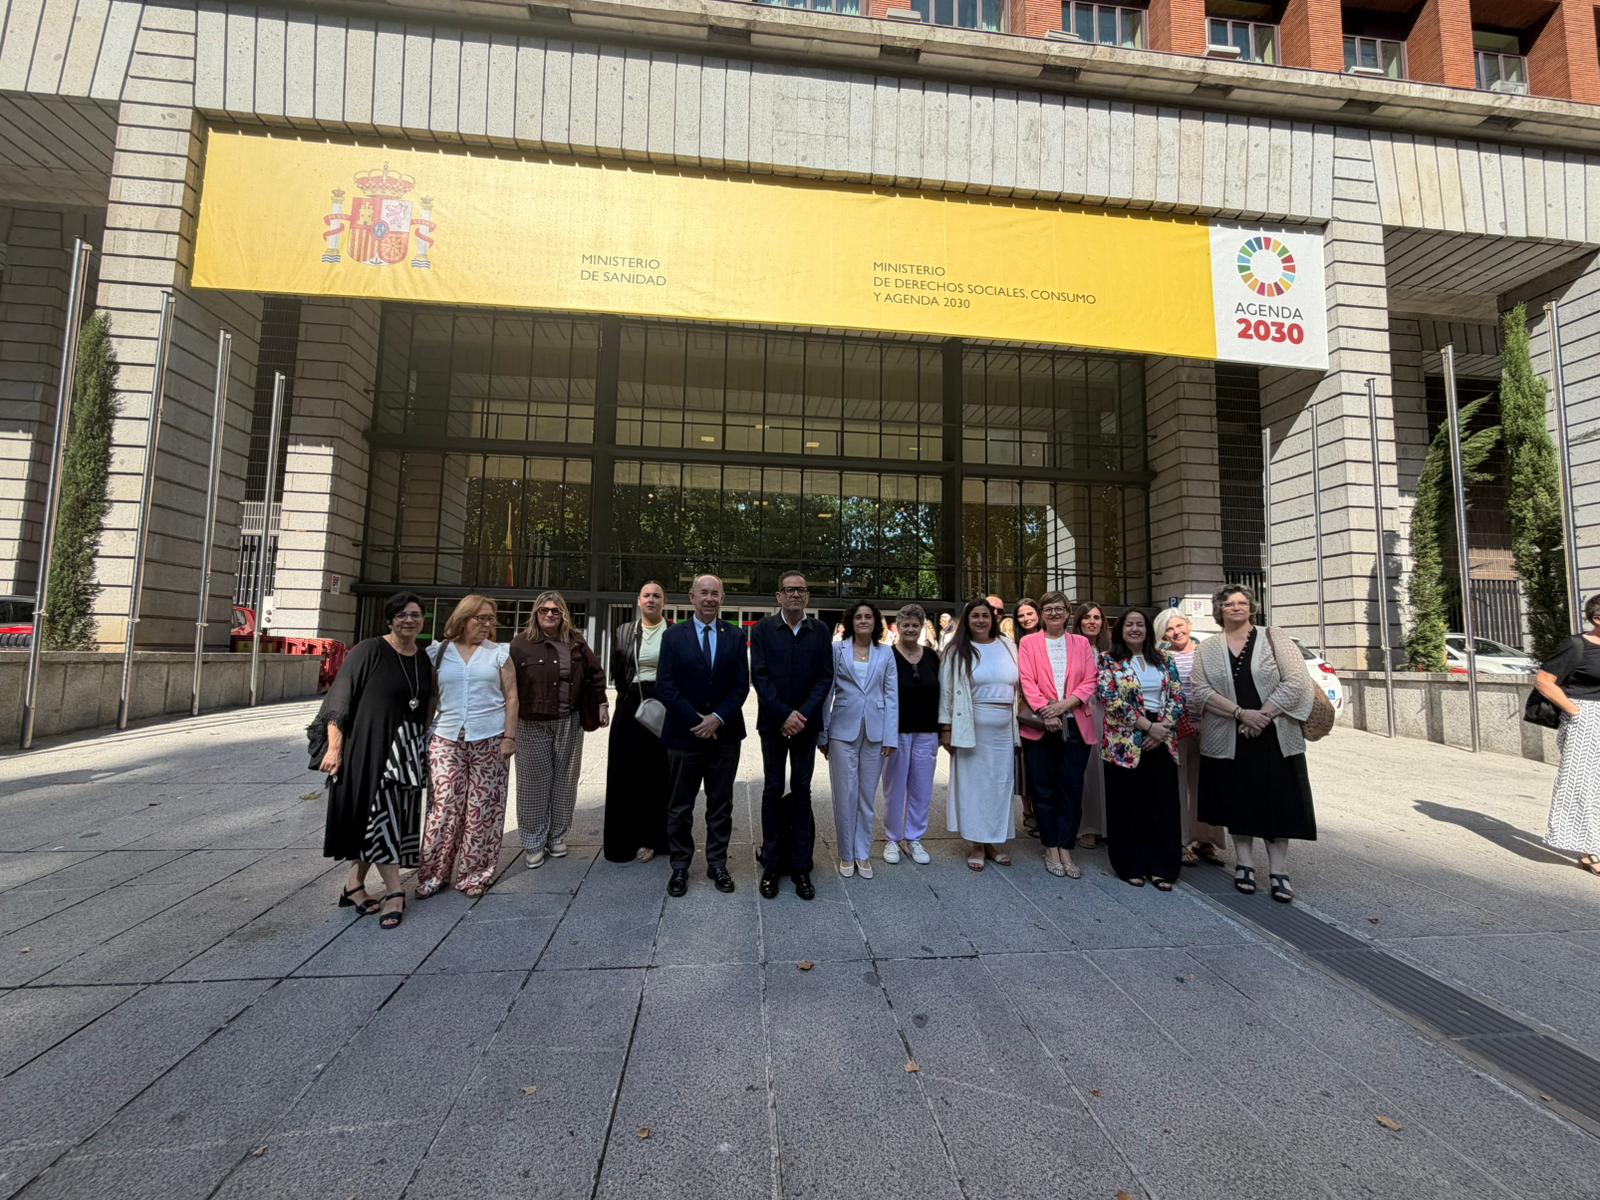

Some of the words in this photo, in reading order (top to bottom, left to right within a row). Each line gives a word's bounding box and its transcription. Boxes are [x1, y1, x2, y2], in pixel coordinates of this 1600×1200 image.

[582, 254, 660, 270] MINISTERIO
[873, 262, 946, 277] MINISTERIO
[581, 270, 599, 281] DE
[603, 272, 667, 286] SANIDAD
[873, 277, 891, 288] DE
[895, 278, 964, 293] DERECHOS
[967, 284, 1028, 300] SOCIALES,
[1030, 289, 1097, 305] CONSUMO
[873, 292, 882, 302] Y
[884, 293, 940, 306] AGENDA
[943, 297, 971, 309] 2030
[1234, 302, 1304, 321] AGENDA
[1235, 318, 1304, 345] 2030
[1170, 597, 1177, 607] P
